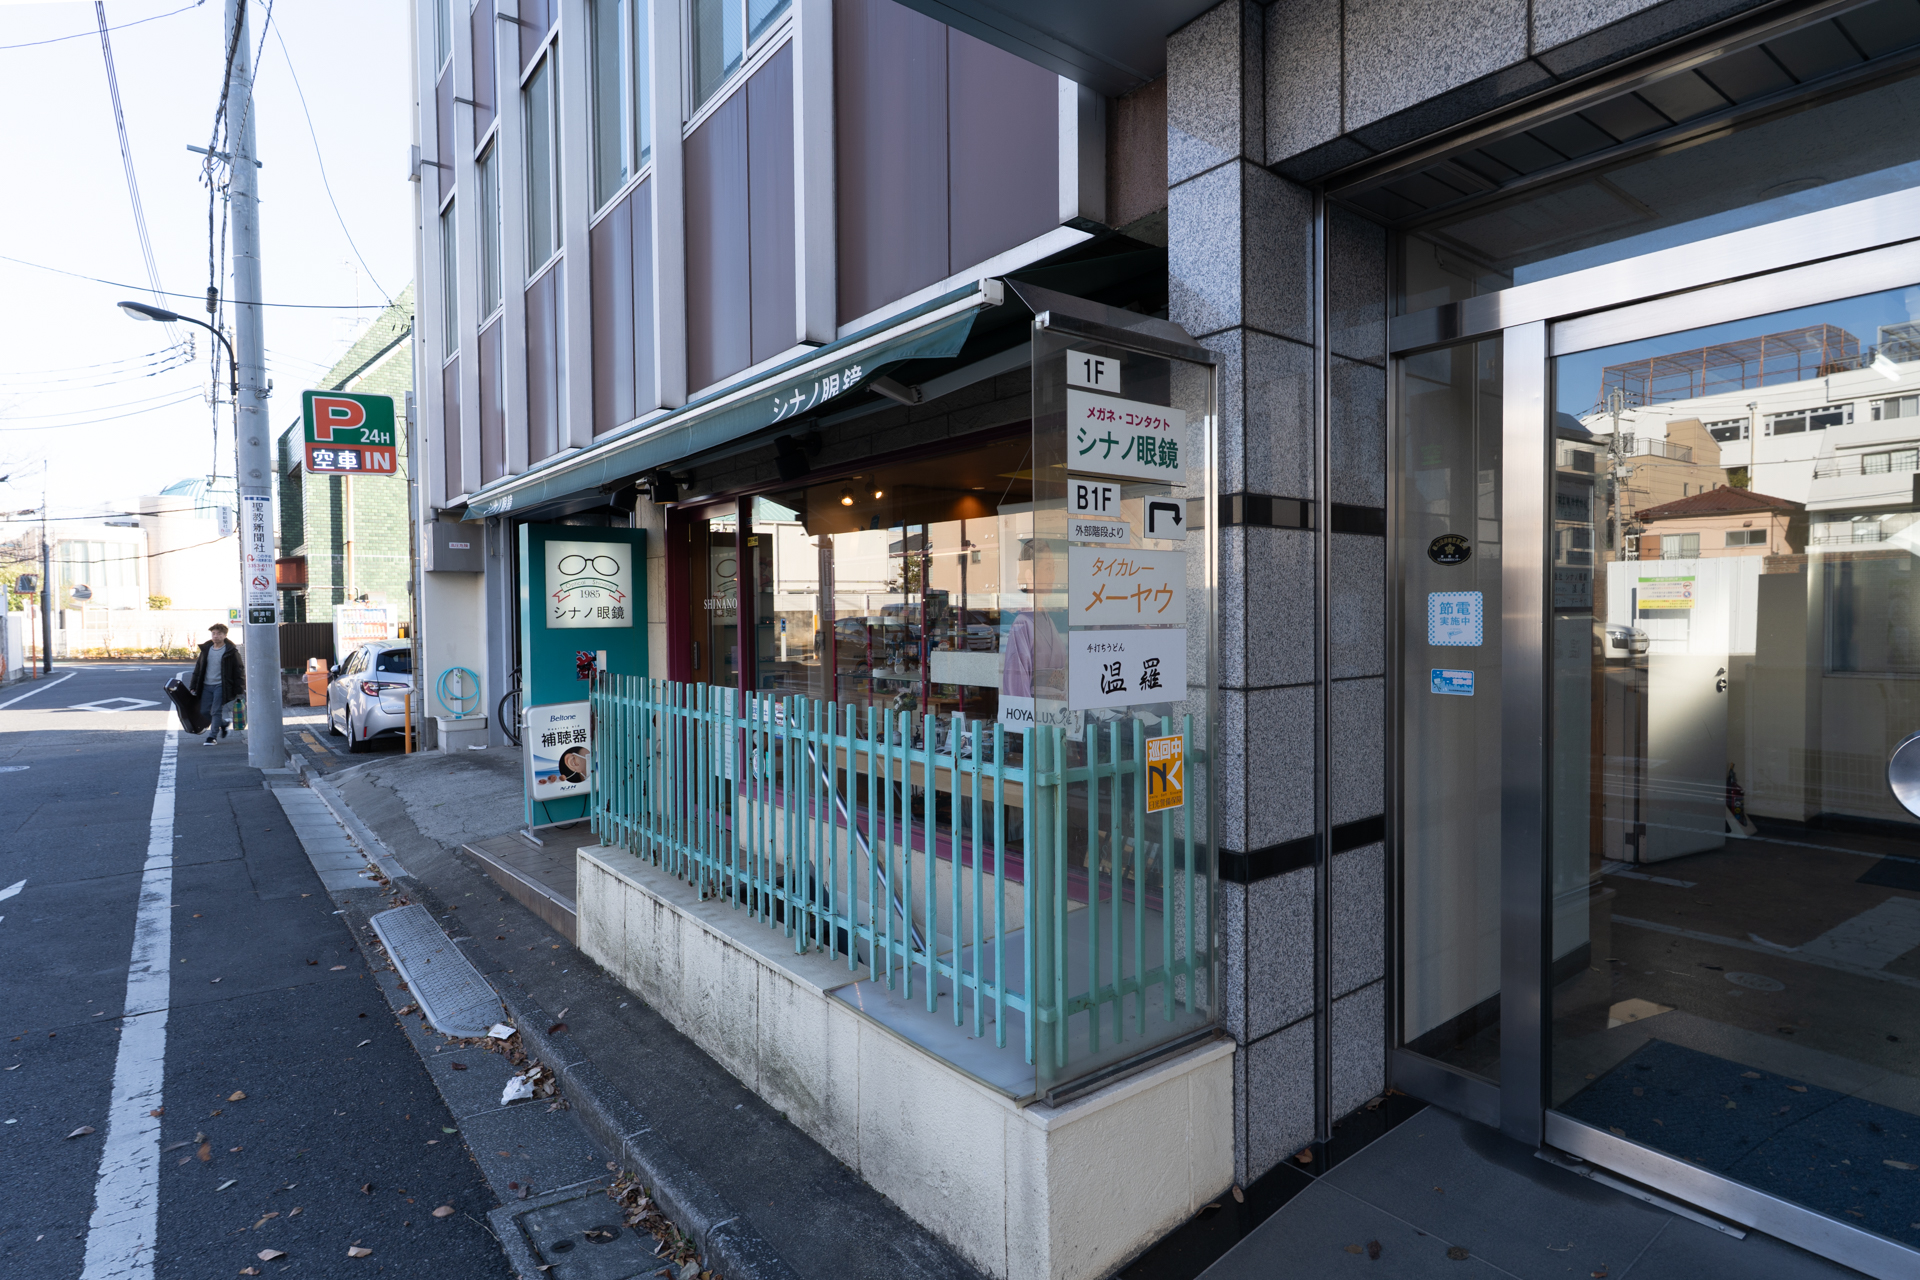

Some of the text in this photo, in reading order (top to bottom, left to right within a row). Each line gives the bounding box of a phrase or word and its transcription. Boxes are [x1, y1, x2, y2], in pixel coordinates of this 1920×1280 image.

[1084, 359, 1104, 384] 1F
[312, 396, 366, 441] P
[1087, 407, 1170, 431] メガネ・コンタクト
[360, 428, 390, 444] 24H
[1077, 427, 1178, 469] シナノ眼鏡
[313, 449, 358, 470] 空車
[365, 451, 390, 470] IN
[1077, 485, 1112, 511] B1F
[252, 502, 265, 552] 聖教新聞社
[1075, 525, 1124, 538] 外部階段より
[1092, 557, 1154, 577] タイカレー
[580, 590, 600, 598] 1985
[704, 598, 738, 609] SHINANO
[1085, 583, 1173, 613] メーヤウ
[554, 606, 625, 619] シナノ眼鏡
[1439, 601, 1471, 615] 節電
[1439, 616, 1471, 626] 実施中
[1087, 643, 1125, 653] 手打ちうどん
[541, 729, 587, 748] 補聴器
[1149, 738, 1181, 762] 巡回中
